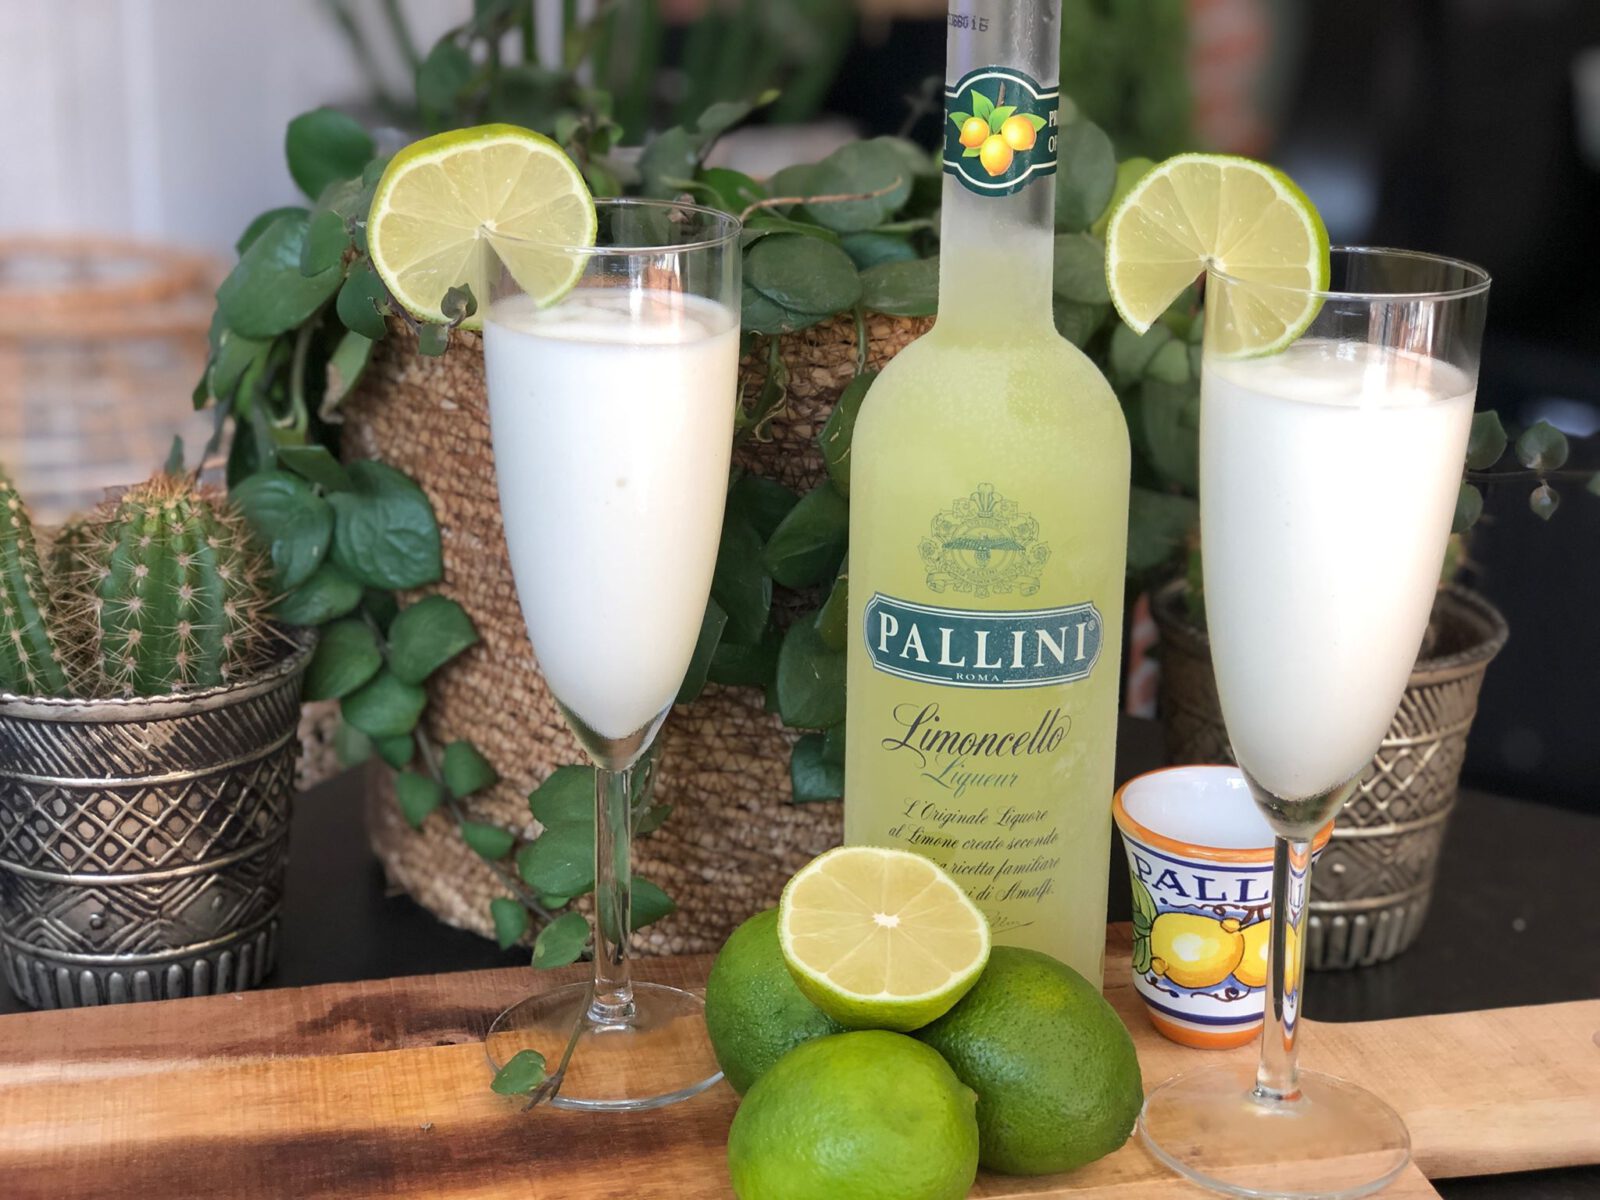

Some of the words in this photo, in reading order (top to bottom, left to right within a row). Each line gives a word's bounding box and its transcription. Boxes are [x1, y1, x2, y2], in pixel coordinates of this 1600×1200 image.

[877, 611, 1088, 668] PALLINI
[955, 672, 1001, 682] ROMA
[881, 702, 1072, 769] Limoncello
[921, 753, 1020, 799] Liqueur
[902, 798, 989, 829] L'Originale
[996, 806, 1049, 831] Liquore
[888, 824, 904, 838] al
[907, 824, 958, 849] Limone
[962, 835, 1005, 850] creato
[1007, 827, 1059, 850] secondo
[951, 861, 995, 875] ricetta
[993, 855, 1061, 882] familiare
[1132, 852, 1270, 903] PALL
[975, 884, 995, 901] di
